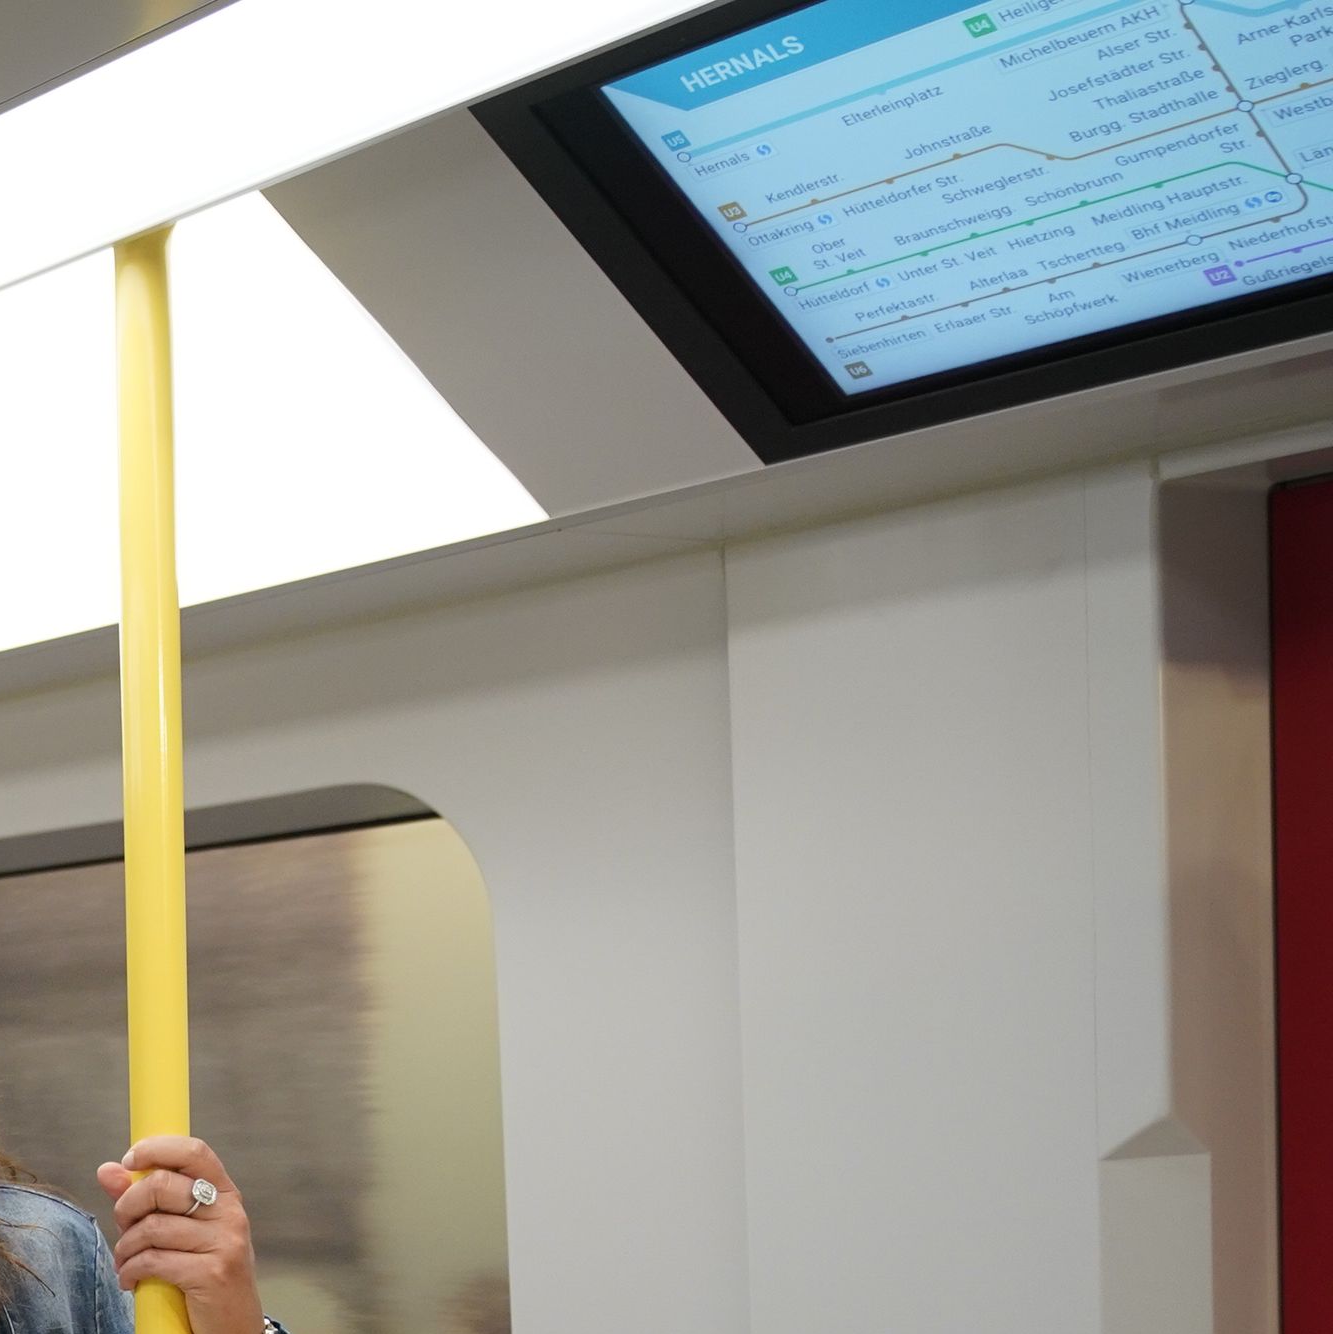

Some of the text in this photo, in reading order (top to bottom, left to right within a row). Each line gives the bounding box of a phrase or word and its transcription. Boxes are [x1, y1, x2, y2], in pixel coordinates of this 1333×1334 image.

[998, 0, 1063, 21] Heilige
[1237, 7, 1333, 44] Arne-Karls
[968, 18, 990, 34] U4
[999, 6, 1161, 69] Michelbeuern AKH
[1289, 25, 1333, 47] Park
[1097, 28, 1177, 60] Alser Str.
[680, 35, 805, 93] HERNALS
[1048, 49, 1191, 102] Josefstädter Str.
[1244, 60, 1328, 90] Zieglerg.
[1093, 69, 1205, 110] Thaliastraße
[841, 85, 943, 127] Elterleinplatz
[1068, 88, 1219, 143] Burgg. Stadthalle
[1273, 96, 1333, 120] Westb
[666, 135, 687, 147] U5
[904, 124, 992, 160] Johnstraße
[1115, 122, 1239, 167] Gumpendorfer
[1219, 138, 1252, 154] Str.
[694, 151, 750, 177] Hernals
[765, 174, 844, 204] Kendlerstr.
[842, 173, 963, 217] Hütteldorfer Str.
[941, 166, 1050, 204] Schweglerstr.
[1024, 171, 1124, 207] Schönbrunn
[1090, 174, 1249, 227] Meidling Hauptstr.
[748, 220, 814, 247] Ottakring
[894, 205, 1016, 246] Braunschweigg.
[1131, 203, 1240, 241] Bhf Meidling
[811, 237, 846, 254] Ober
[1007, 224, 1075, 251] Hietzing
[813, 248, 867, 271] St. Veit
[897, 246, 997, 282] Unter St. Veit
[1037, 240, 1130, 272] Tschertteg.
[1121, 251, 1221, 283] Wienerberg
[1243, 256, 1333, 286] Gußriegels
[775, 270, 793, 282] U4
[969, 268, 1029, 291] Alterlaa
[1208, 269, 1231, 282] U2
[798, 281, 870, 310] Hütteldorf
[854, 292, 938, 322] Perfektastr.
[1024, 294, 1119, 326] Schöpfwerk
[1048, 290, 1075, 303] Am
[933, 304, 1016, 334] Erlaaer Str.
[837, 329, 926, 359] Siebenhirten
[848, 364, 867, 376] U6
